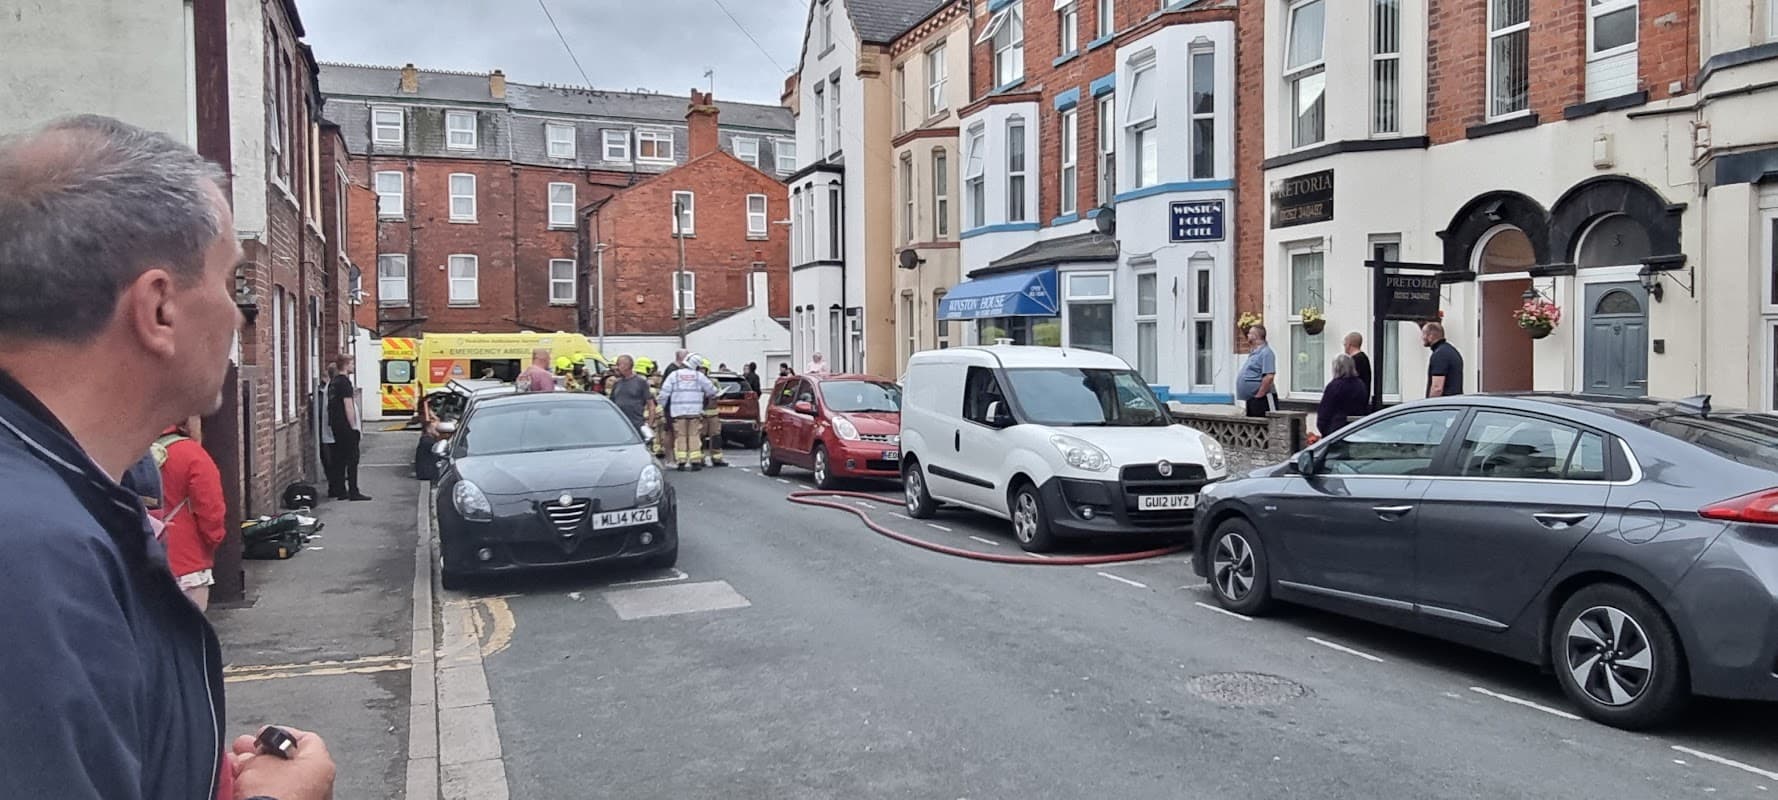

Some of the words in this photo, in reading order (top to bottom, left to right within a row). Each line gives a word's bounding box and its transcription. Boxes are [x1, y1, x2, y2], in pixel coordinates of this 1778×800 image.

[1271, 175, 1332, 200] PRETORIA
[1173, 205, 1221, 214] WINSTON
[1179, 216, 1214, 226] HOUSE
[1179, 227, 1212, 237] HOTEL
[1386, 276, 1439, 289] PRETORIA
[948, 299, 977, 312] WINSTON
[980, 294, 1006, 310] HOUSE
[449, 348, 501, 356] EMERGENCY
[1145, 496, 1168, 508] GU12
[1170, 495, 1190, 507] UYZ
[601, 512, 628, 526] ML14
[631, 508, 653, 522] KZG
